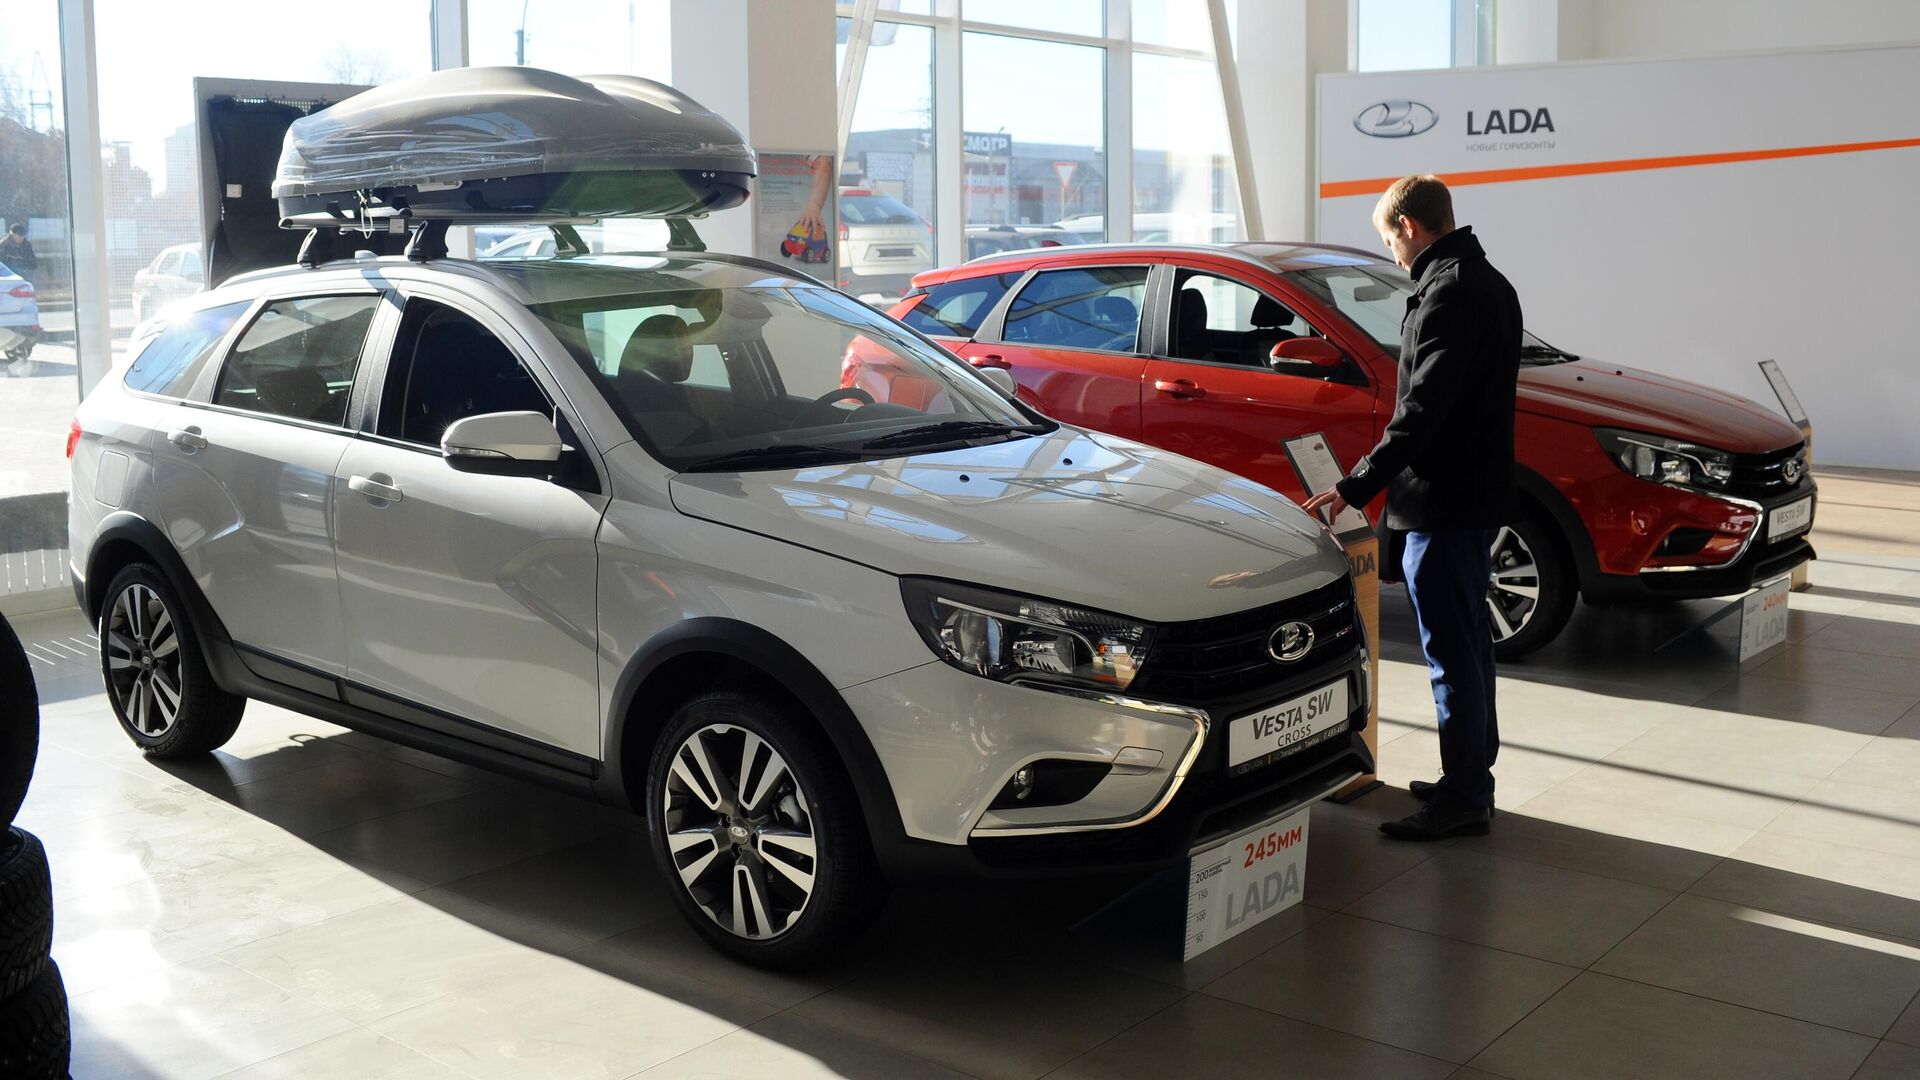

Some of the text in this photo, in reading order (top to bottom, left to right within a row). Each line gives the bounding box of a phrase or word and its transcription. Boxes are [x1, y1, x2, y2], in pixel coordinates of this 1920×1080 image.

[1467, 107, 1555, 136] LADA
[1466, 140, 1556, 152] НОВЫЕ ГОРИЗОНТЫ
[1756, 614, 1786, 647] LADA
[1252, 706, 1303, 741] VESTA
[1306, 689, 1334, 720] SW
[1277, 723, 1312, 747] CROSS
[1196, 869, 1209, 884] 200
[1198, 890, 1209, 901] 150
[1225, 862, 1300, 930] LADA
[1196, 911, 1207, 923] 100
[1195, 934, 1204, 944] 50
